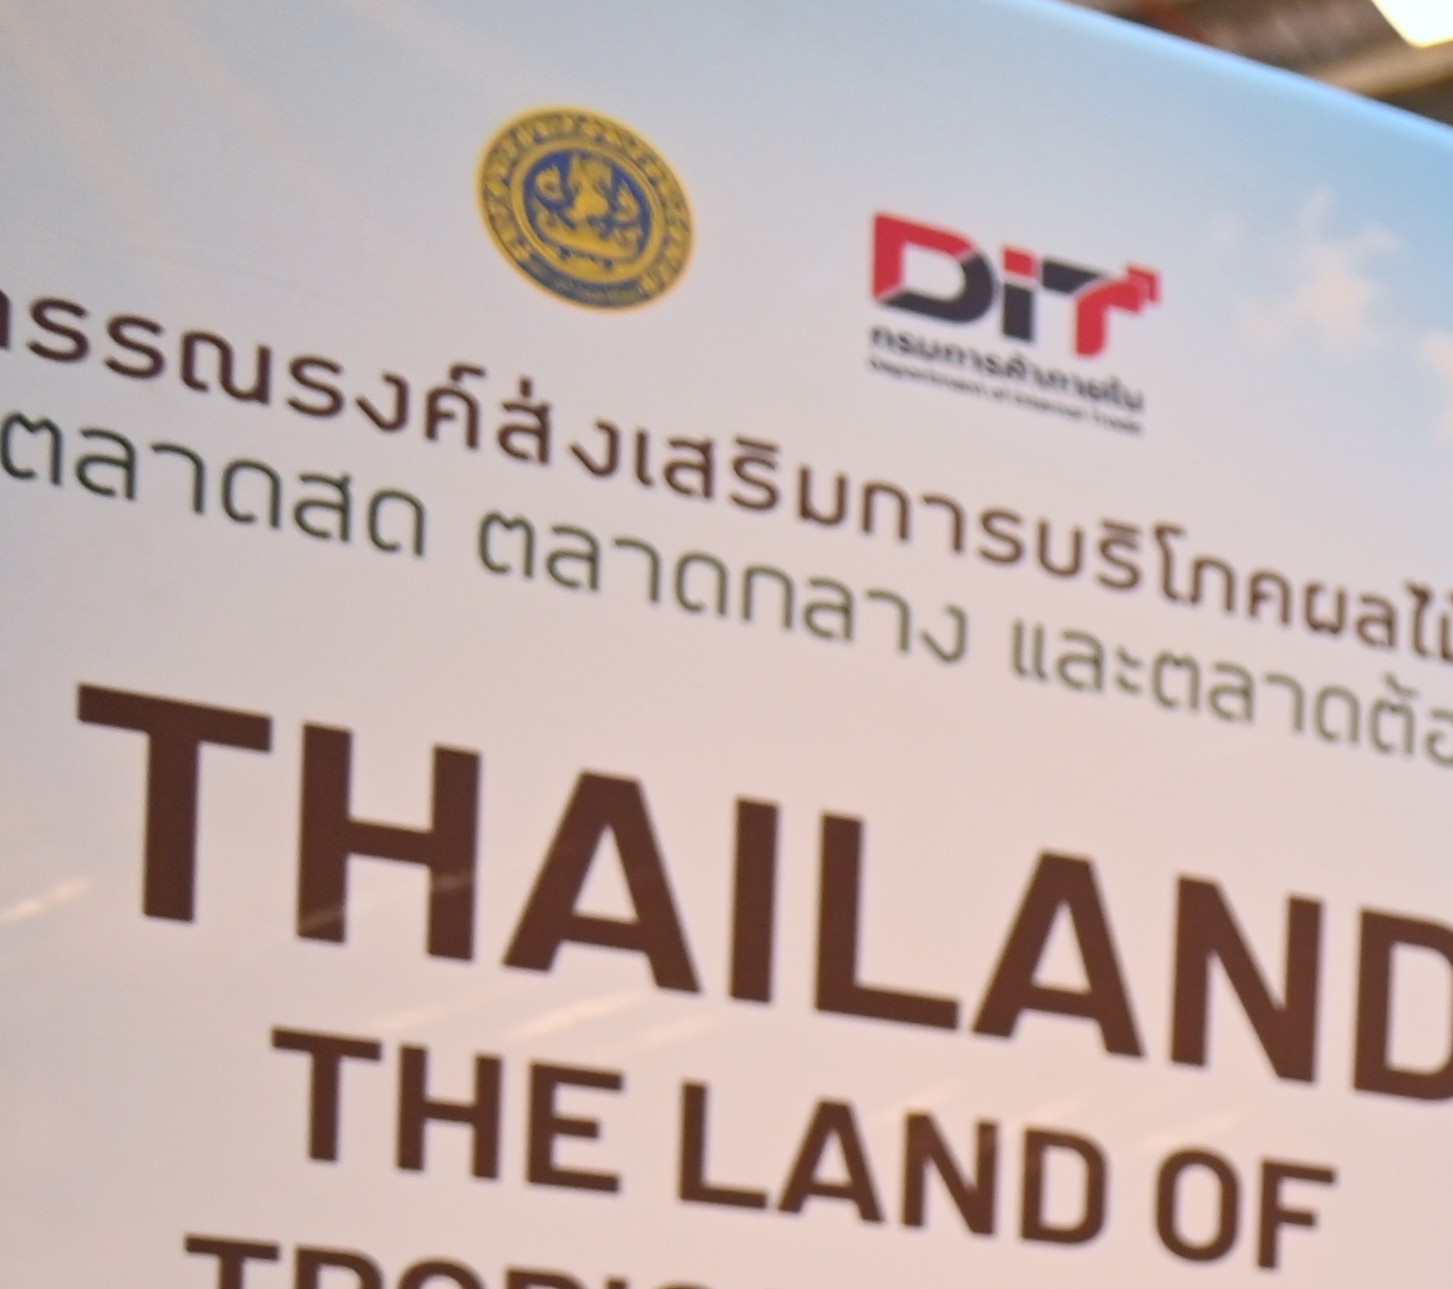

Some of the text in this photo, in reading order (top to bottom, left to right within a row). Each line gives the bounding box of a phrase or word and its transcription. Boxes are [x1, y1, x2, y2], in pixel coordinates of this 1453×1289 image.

[1, 412, 425, 557] ตลาดสด
[478, 510, 968, 663] ตลาดกลาง
[271, 1026, 1338, 1271] THE LAND OF
